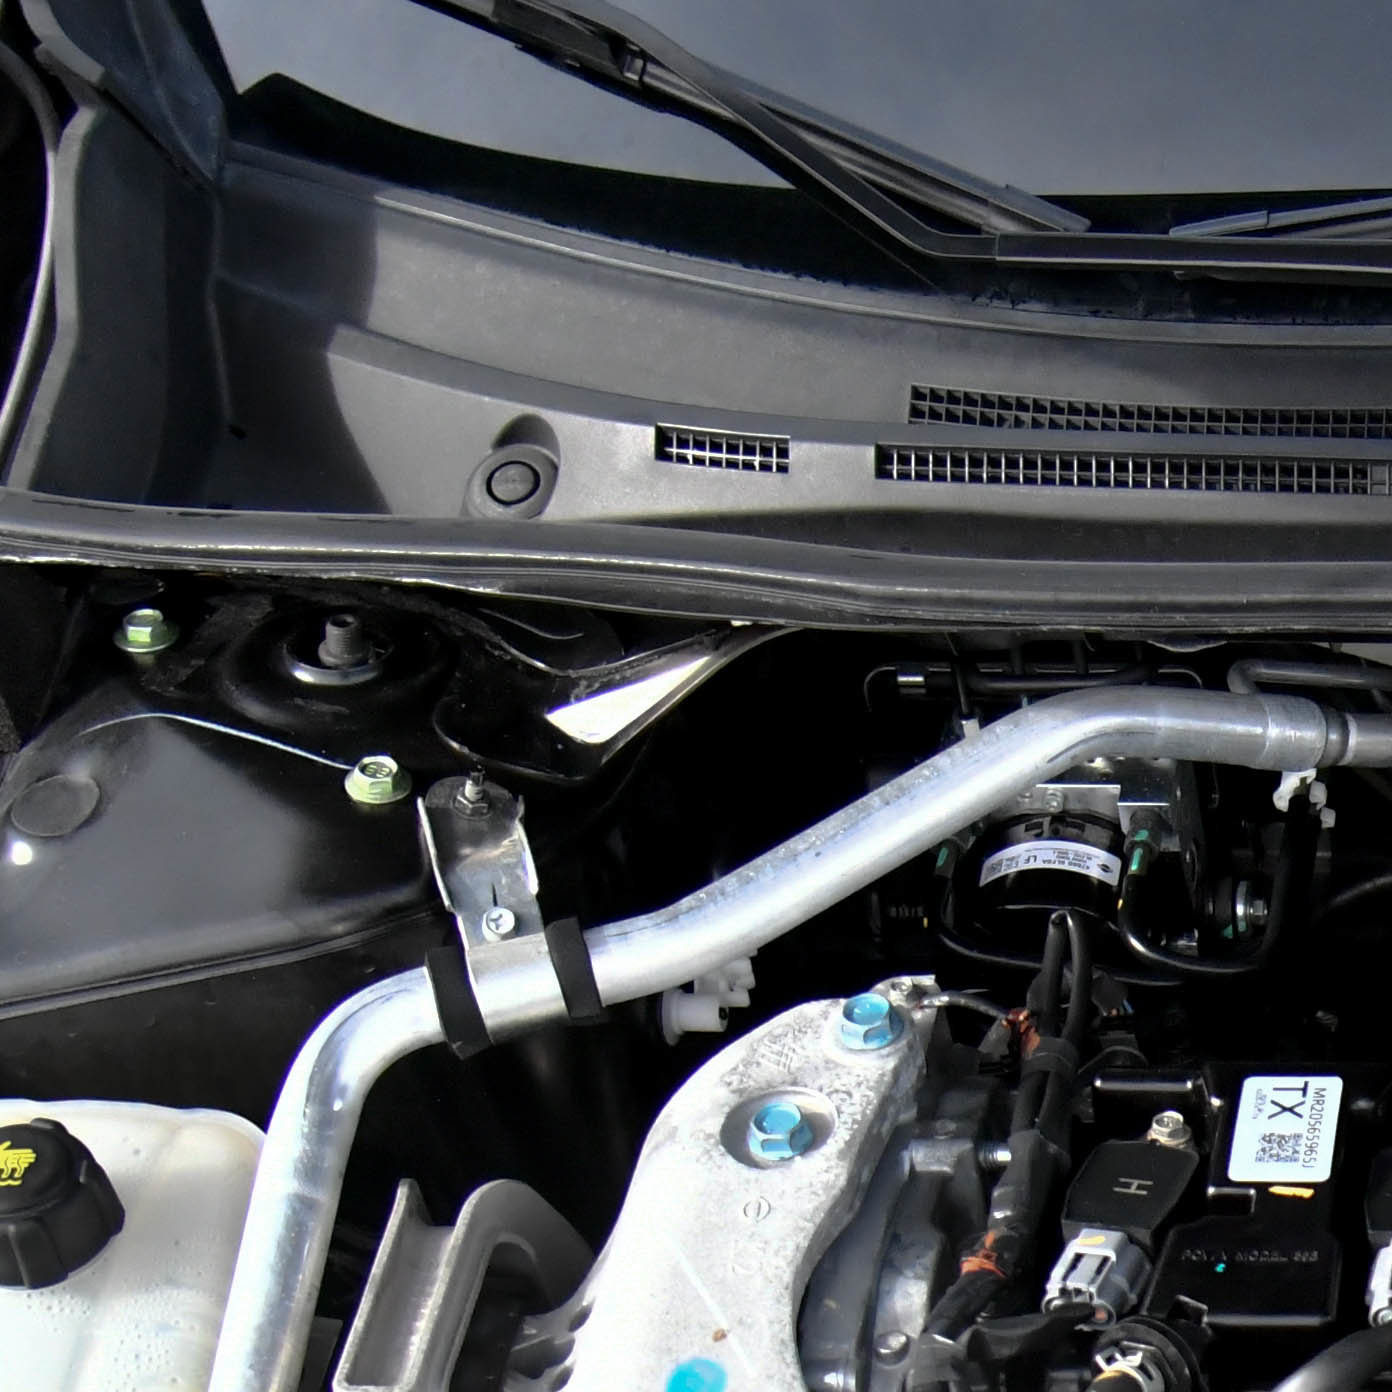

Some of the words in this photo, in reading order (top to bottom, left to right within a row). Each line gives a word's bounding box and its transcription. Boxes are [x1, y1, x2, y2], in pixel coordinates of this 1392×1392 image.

[1023, 855, 1038, 865] LF
[1267, 1081, 1309, 1120] TX
[1112, 1177, 1154, 1195] H
